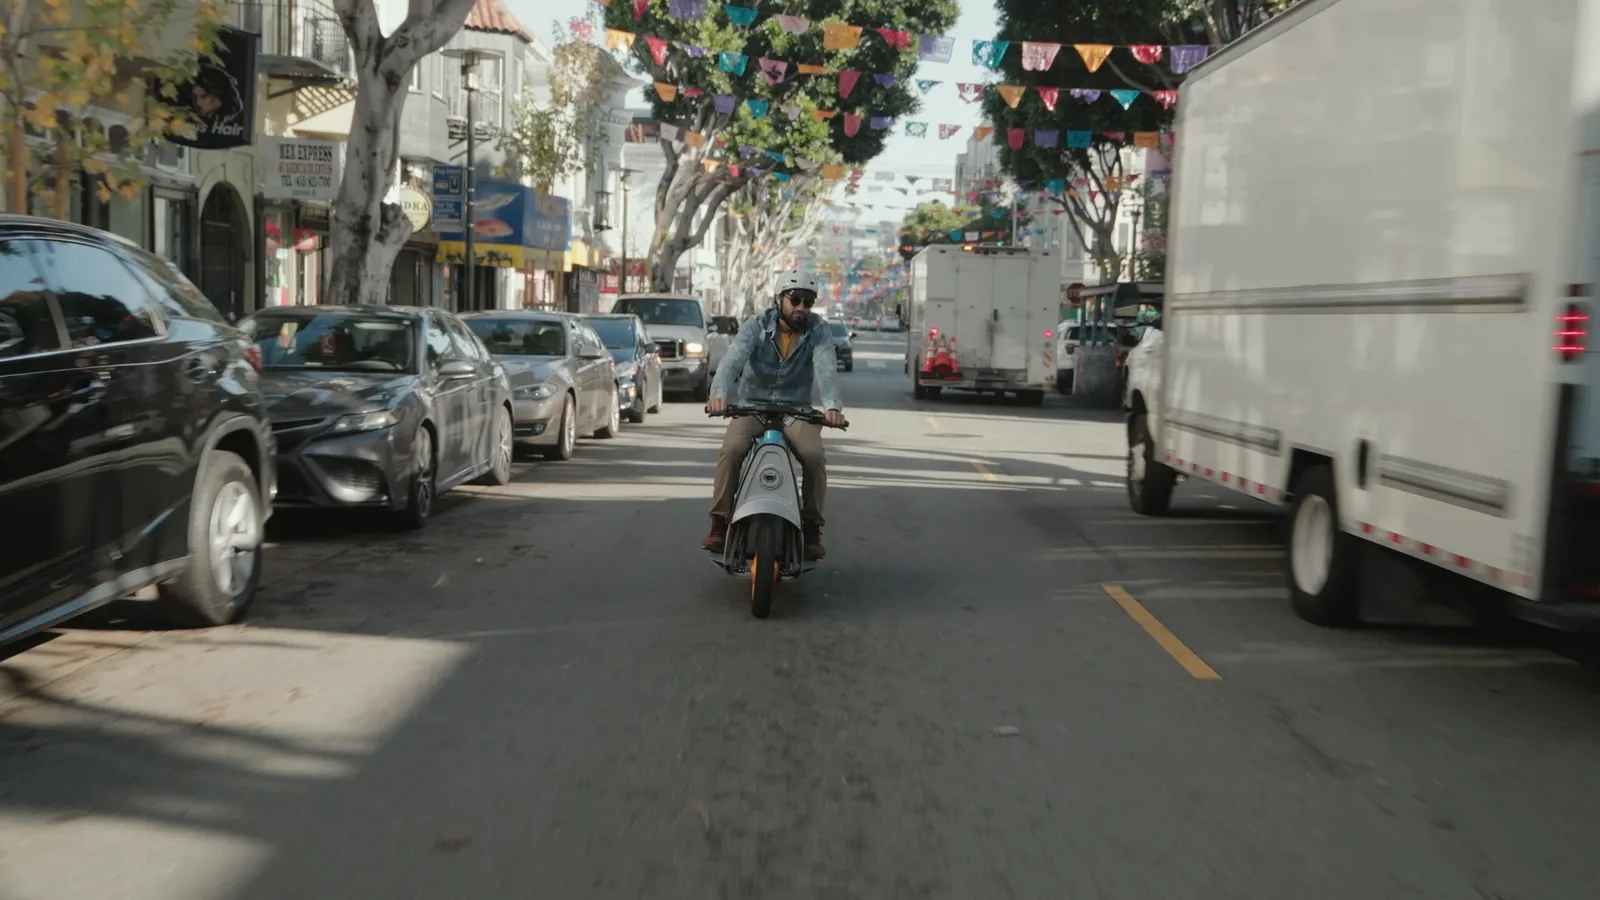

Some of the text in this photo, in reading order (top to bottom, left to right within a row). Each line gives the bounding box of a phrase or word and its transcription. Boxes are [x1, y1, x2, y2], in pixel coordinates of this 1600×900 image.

[211, 121, 244, 136] Hair
[297, 144, 333, 162] EXPRESS
[280, 174, 293, 187] TEL
